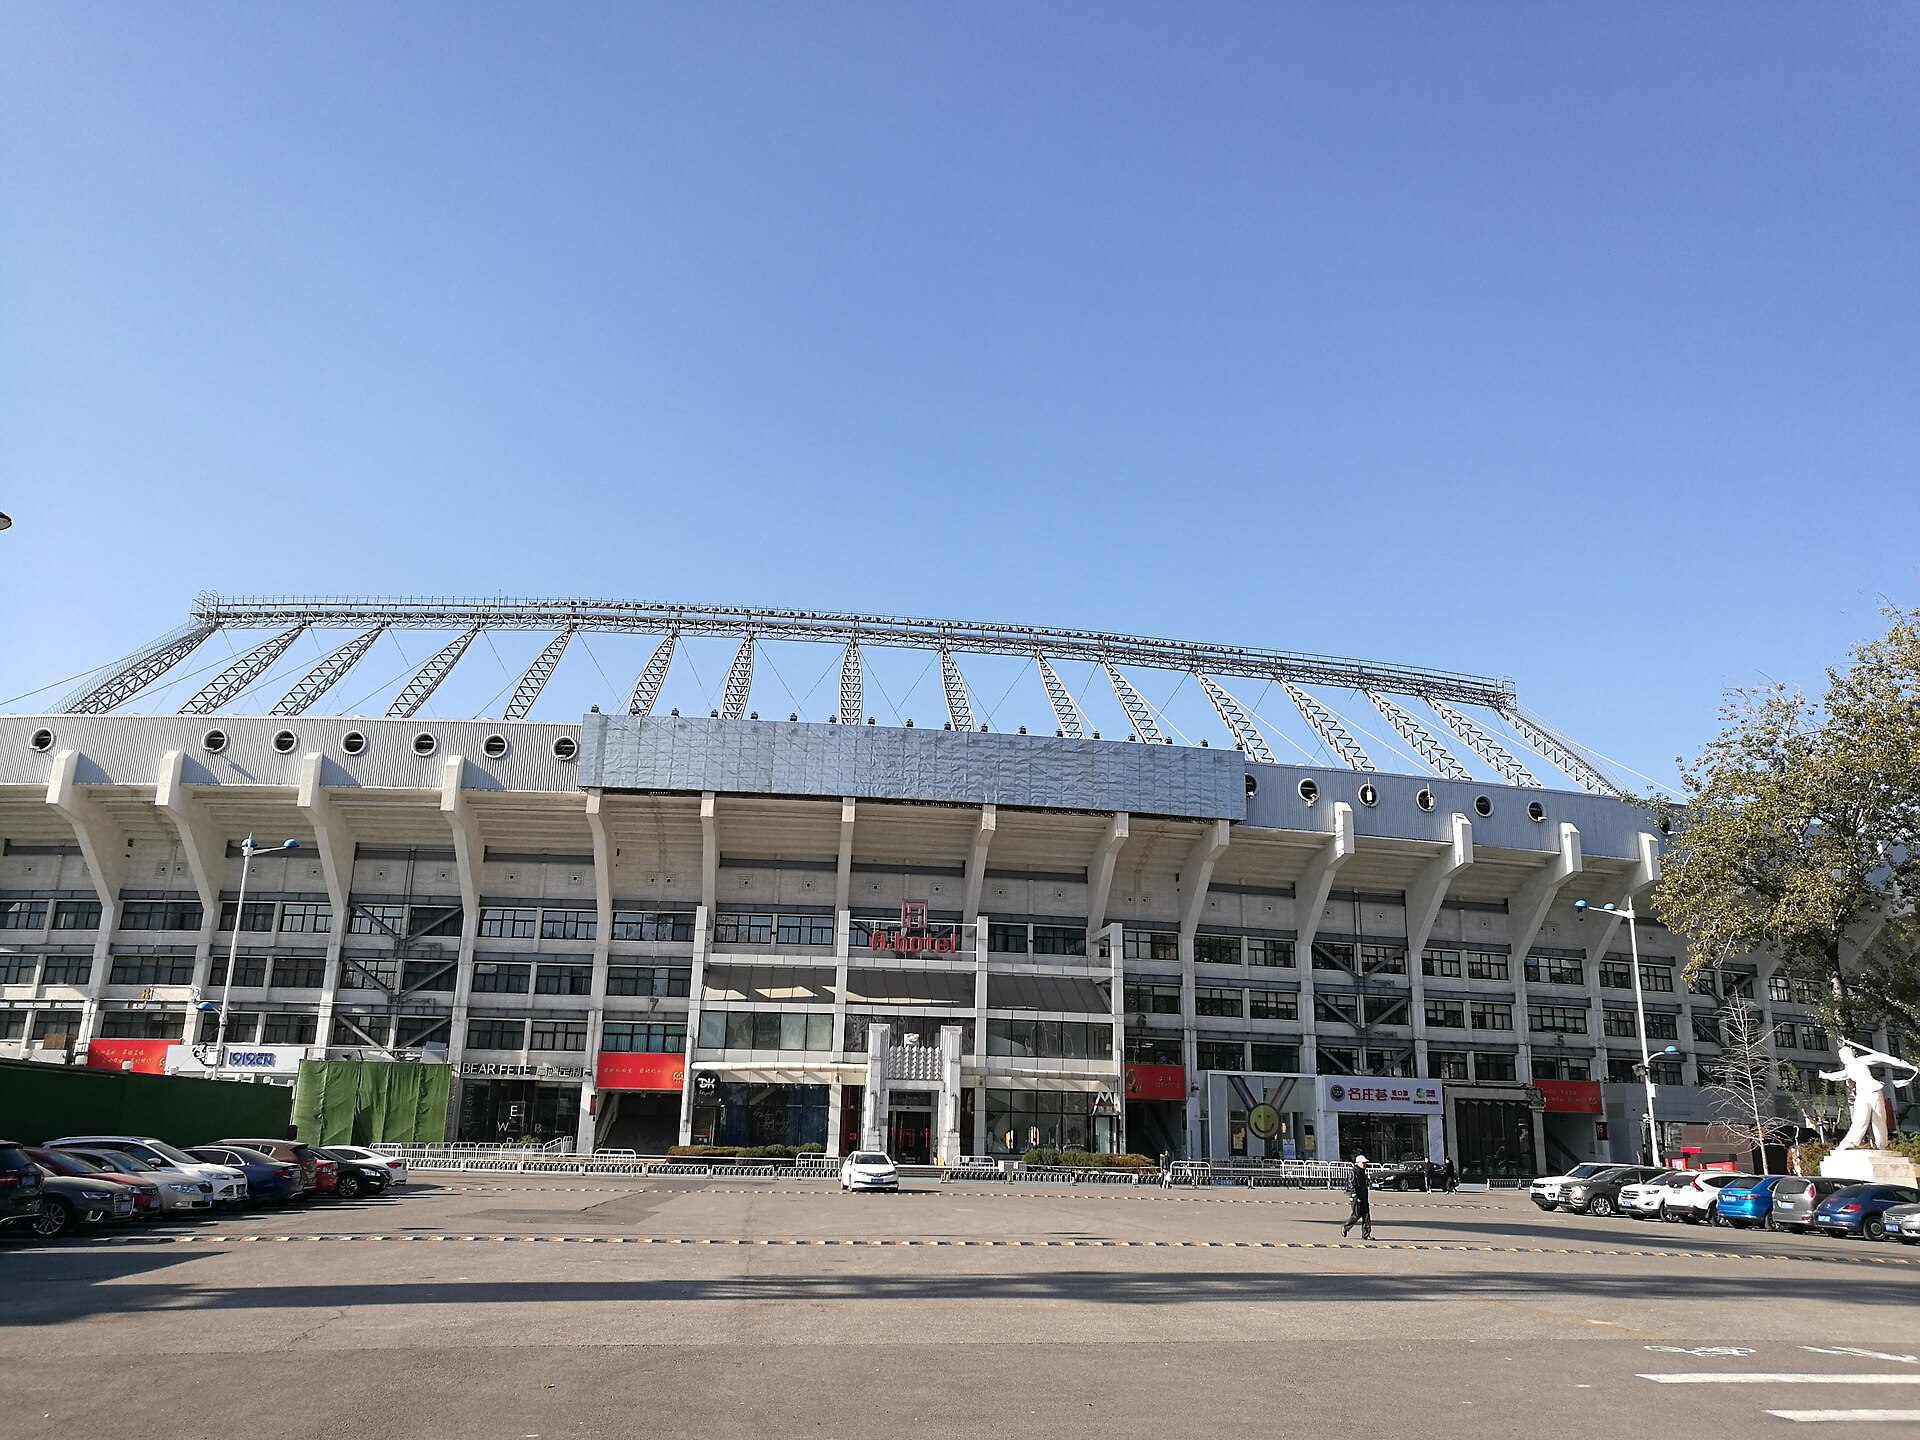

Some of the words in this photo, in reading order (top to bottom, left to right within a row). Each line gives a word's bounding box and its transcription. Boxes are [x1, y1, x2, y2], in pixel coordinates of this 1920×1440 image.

[649, 997, 660, 1013] 7
[462, 1062, 496, 1075] BEAR
[500, 1064, 532, 1076] FETE
[465, 1083, 475, 1107] BEAR
[1348, 1087, 1388, 1101] 名庄荟
[510, 1105, 518, 1117] E
[497, 1121, 510, 1132] W
